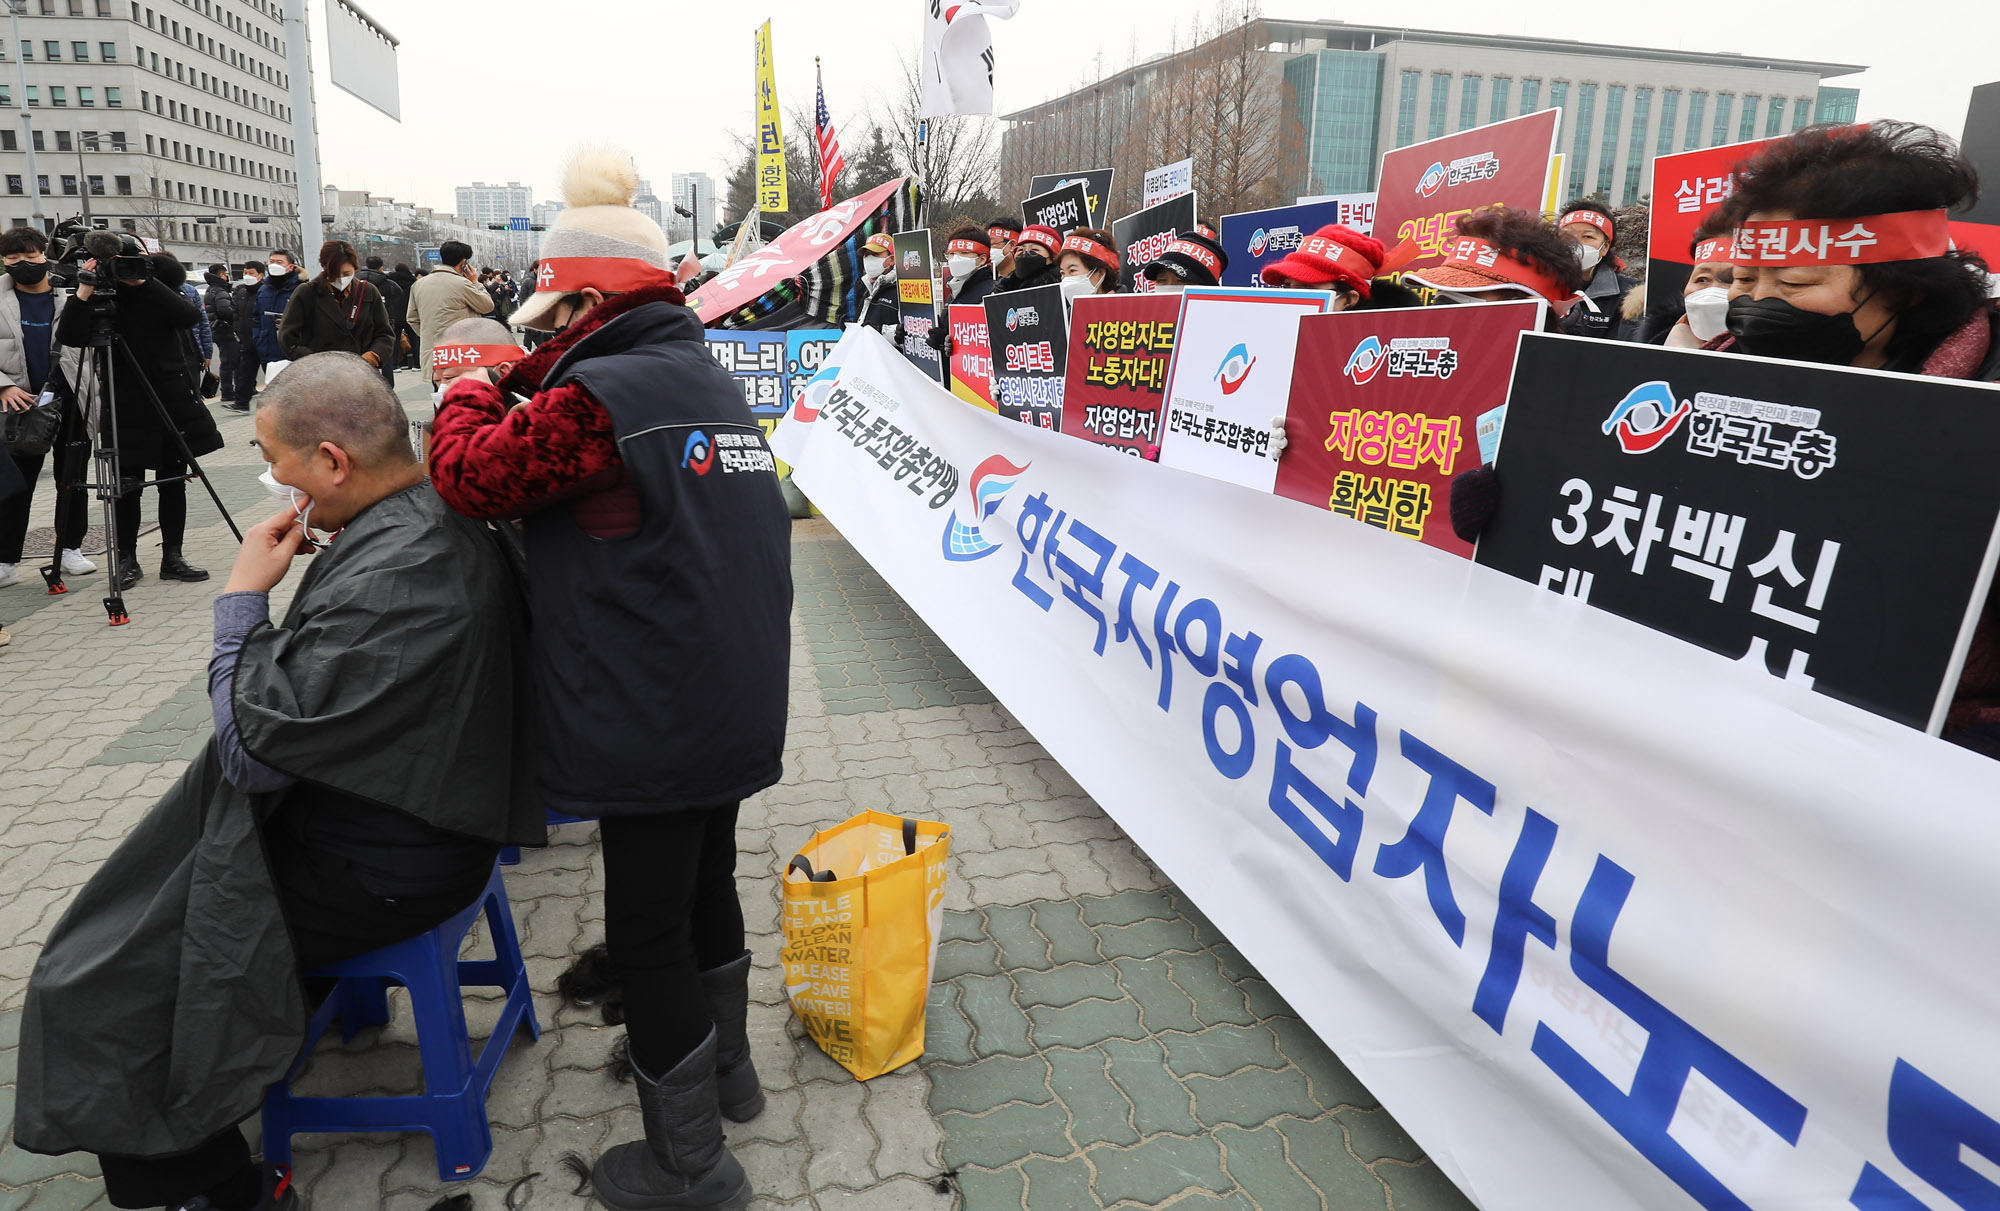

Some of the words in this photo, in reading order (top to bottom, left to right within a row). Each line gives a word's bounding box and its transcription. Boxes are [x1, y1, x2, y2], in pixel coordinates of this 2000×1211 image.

[1449, 159, 1498, 186] 한국노총
[1674, 172, 1738, 213] 살려
[1036, 198, 1079, 228] 자영업자
[1733, 223, 1878, 260] 존권사수
[953, 322, 990, 348] 자살자폭
[1085, 320, 1175, 351] 자영업자도
[1006, 341, 1054, 373] 오미크론
[1086, 356, 1165, 389] 노동자다!
[1388, 350, 1456, 378] 한국노총
[1697, 395, 1728, 411] 현장과
[1755, 404, 1787, 420] 국민과
[1084, 405, 1156, 442] 자영업자
[1170, 408, 1274, 460] 한국노동조합총연
[819, 387, 959, 510] 한국노동조합총연맹
[1325, 409, 1462, 474] 자영업자
[1688, 413, 1836, 479] 한국노총
[1329, 471, 1432, 540] 확실한
[1551, 477, 1841, 635] 3차백신
[800, 923, 852, 938] LOVE
[811, 912, 852, 926] AND
[784, 946, 853, 965] WATER.
[791, 931, 852, 950] CLEAN
[790, 964, 850, 982] PLEASE
[812, 982, 851, 999] SAVE
